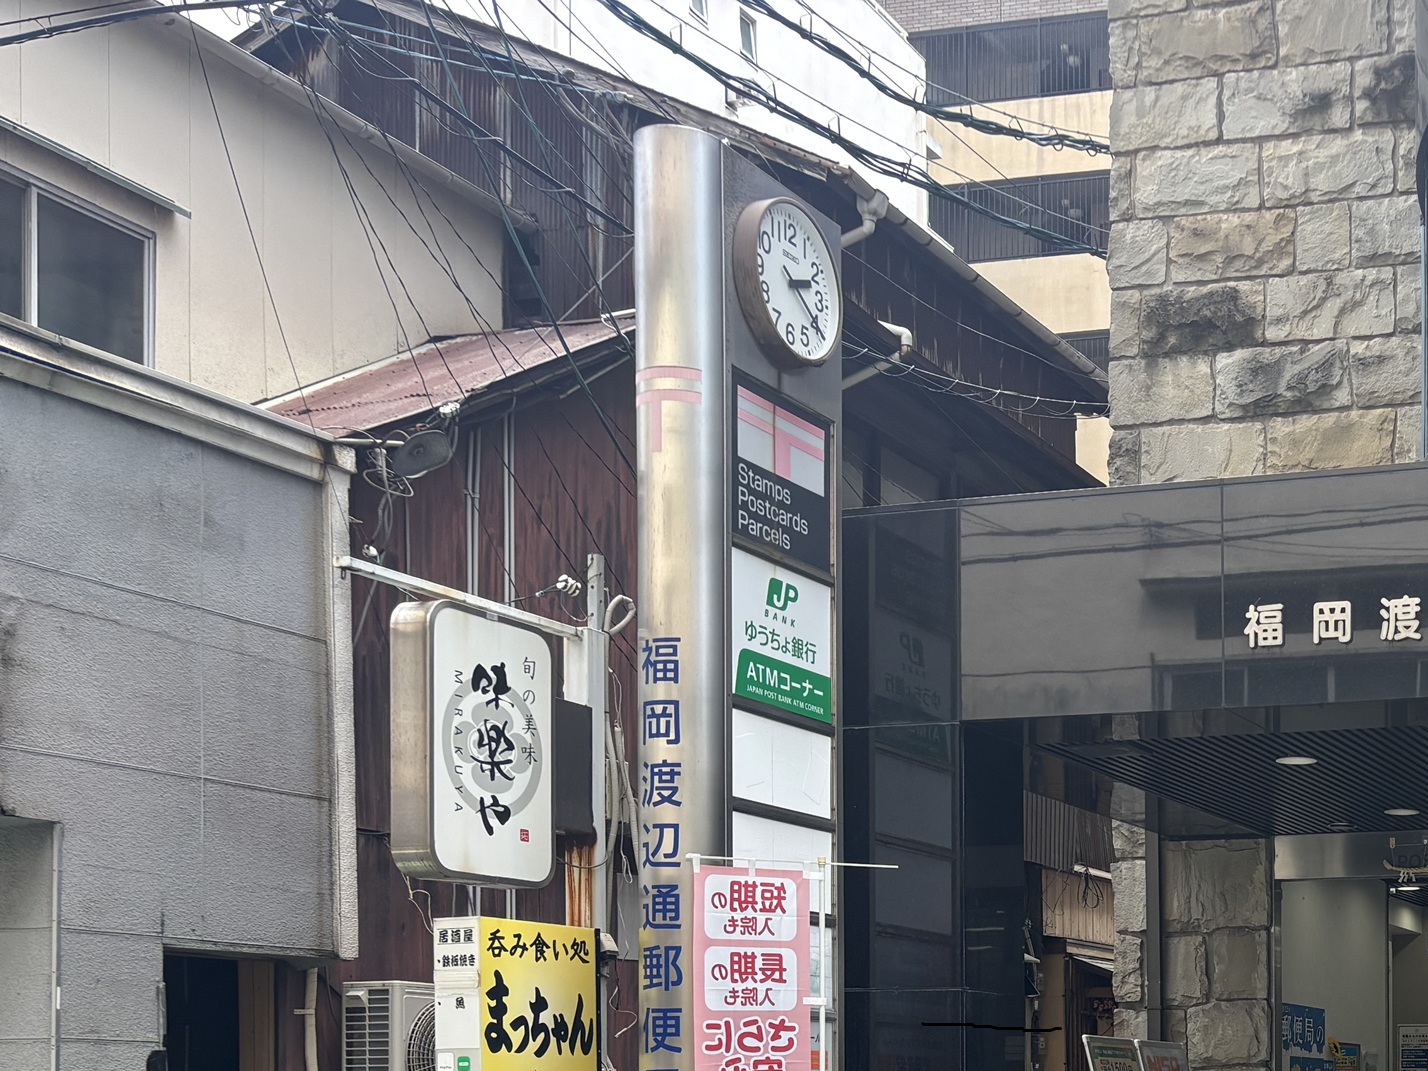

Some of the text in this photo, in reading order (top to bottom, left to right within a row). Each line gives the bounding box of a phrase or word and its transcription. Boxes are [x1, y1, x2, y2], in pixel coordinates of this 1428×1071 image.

[784, 219, 797, 248] 12
[811, 262, 820, 286] 2
[772, 307, 781, 327] 7
[815, 290, 824, 313] 3
[786, 323, 795, 346] 6
[800, 324, 810, 347] 5
[738, 463, 791, 505] Stamps
[738, 486, 809, 535] Postcards
[738, 509, 791, 550] Parcels
[766, 577, 798, 611] JP
[764, 609, 796, 628] BANK
[745, 620, 817, 665] ゆうちょ銀行
[747, 661, 824, 697] ATMコーナー
[522, 656, 538, 766] 旬の美味
[746, 684, 824, 715] JAPAN POST BANK ATM CORNER
[454, 669, 464, 812] MIRAKUYA
[470, 662, 516, 836] 味楽や
[439, 929, 473, 943] 居酒屋
[486, 928, 590, 964] 呑み食い処
[484, 969, 594, 1058] まっちゃん
[1282, 1015, 1324, 1044] 郵便局の
